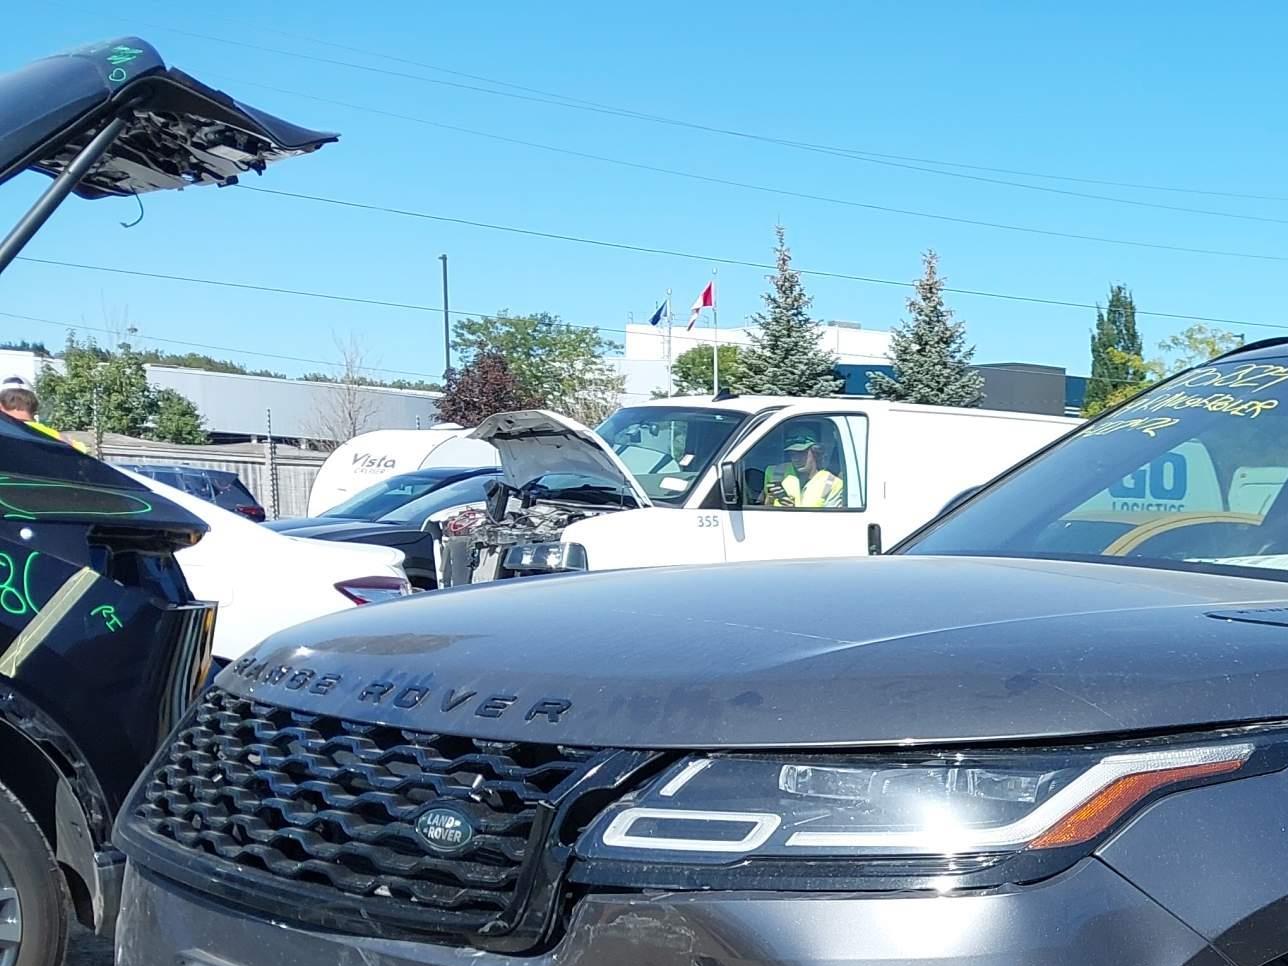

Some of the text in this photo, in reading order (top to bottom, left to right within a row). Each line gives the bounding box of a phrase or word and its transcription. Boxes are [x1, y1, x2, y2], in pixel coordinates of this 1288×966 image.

[351, 452, 396, 469] Vista
[696, 515, 720, 528] 355
[232, 656, 574, 725] RANGE ROVER
[426, 812, 455, 829] LAND
[427, 826, 463, 843] ROVER
